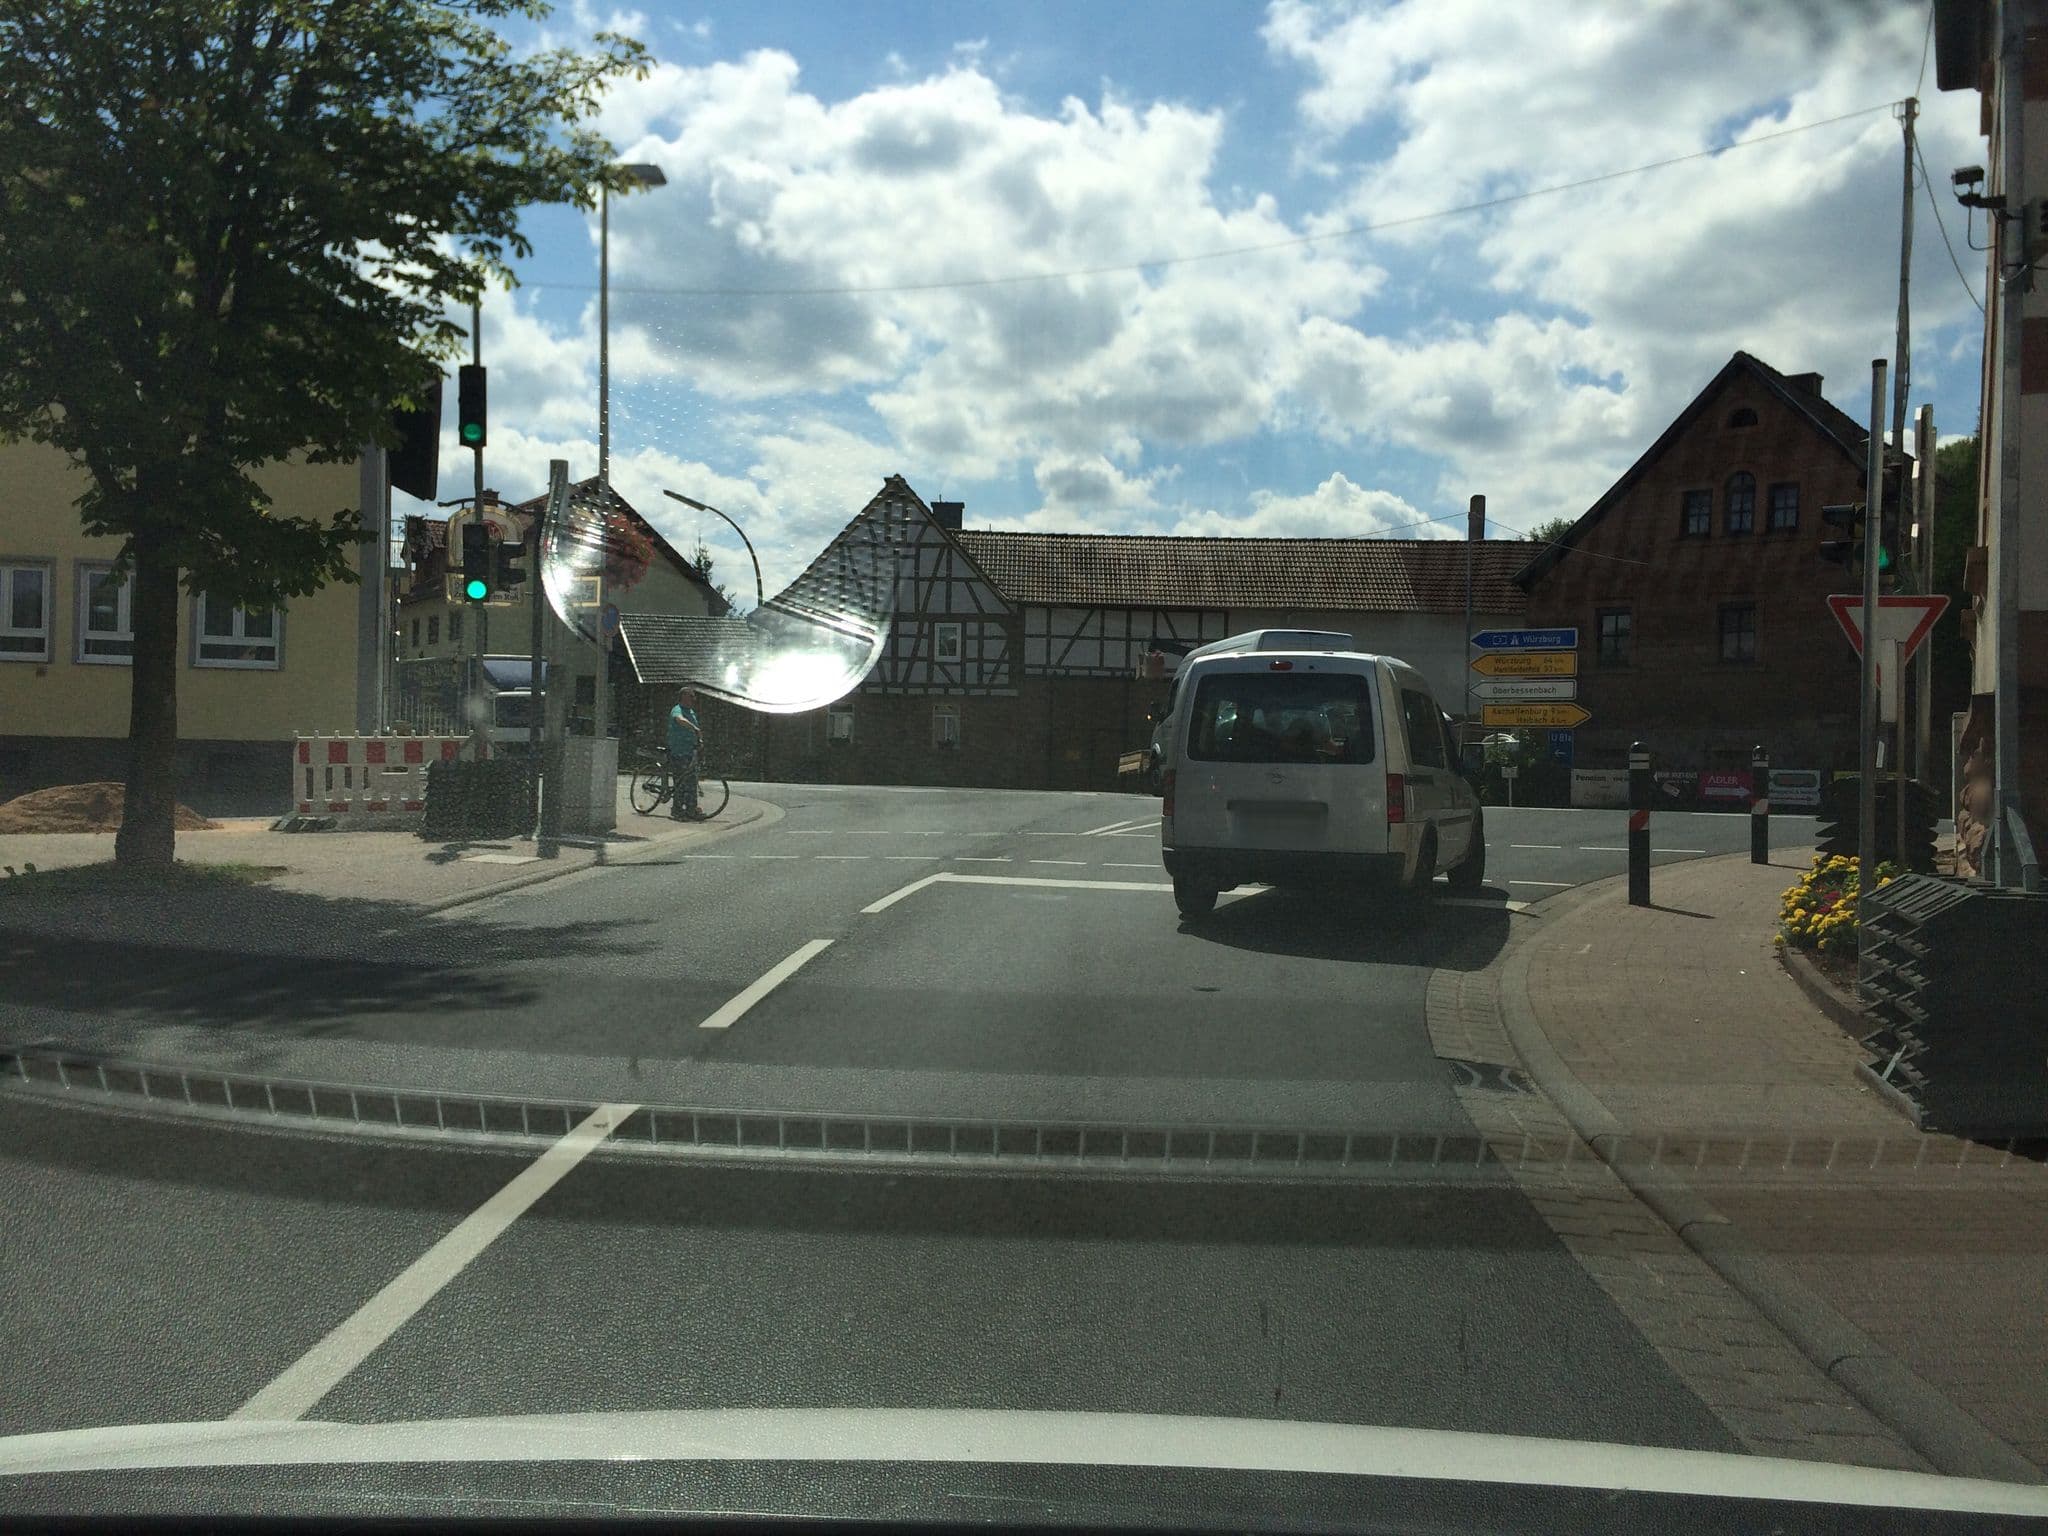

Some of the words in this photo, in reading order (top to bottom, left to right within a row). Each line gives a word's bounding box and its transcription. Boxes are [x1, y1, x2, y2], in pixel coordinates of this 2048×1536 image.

[1522, 634, 1561, 645] Würzburg
[1495, 656, 1532, 665] Würzburg
[1493, 686, 1557, 695] Oberbessenbach
[1492, 707, 1548, 716] Aschaffenburg
[1708, 775, 1738, 784] ADLER
